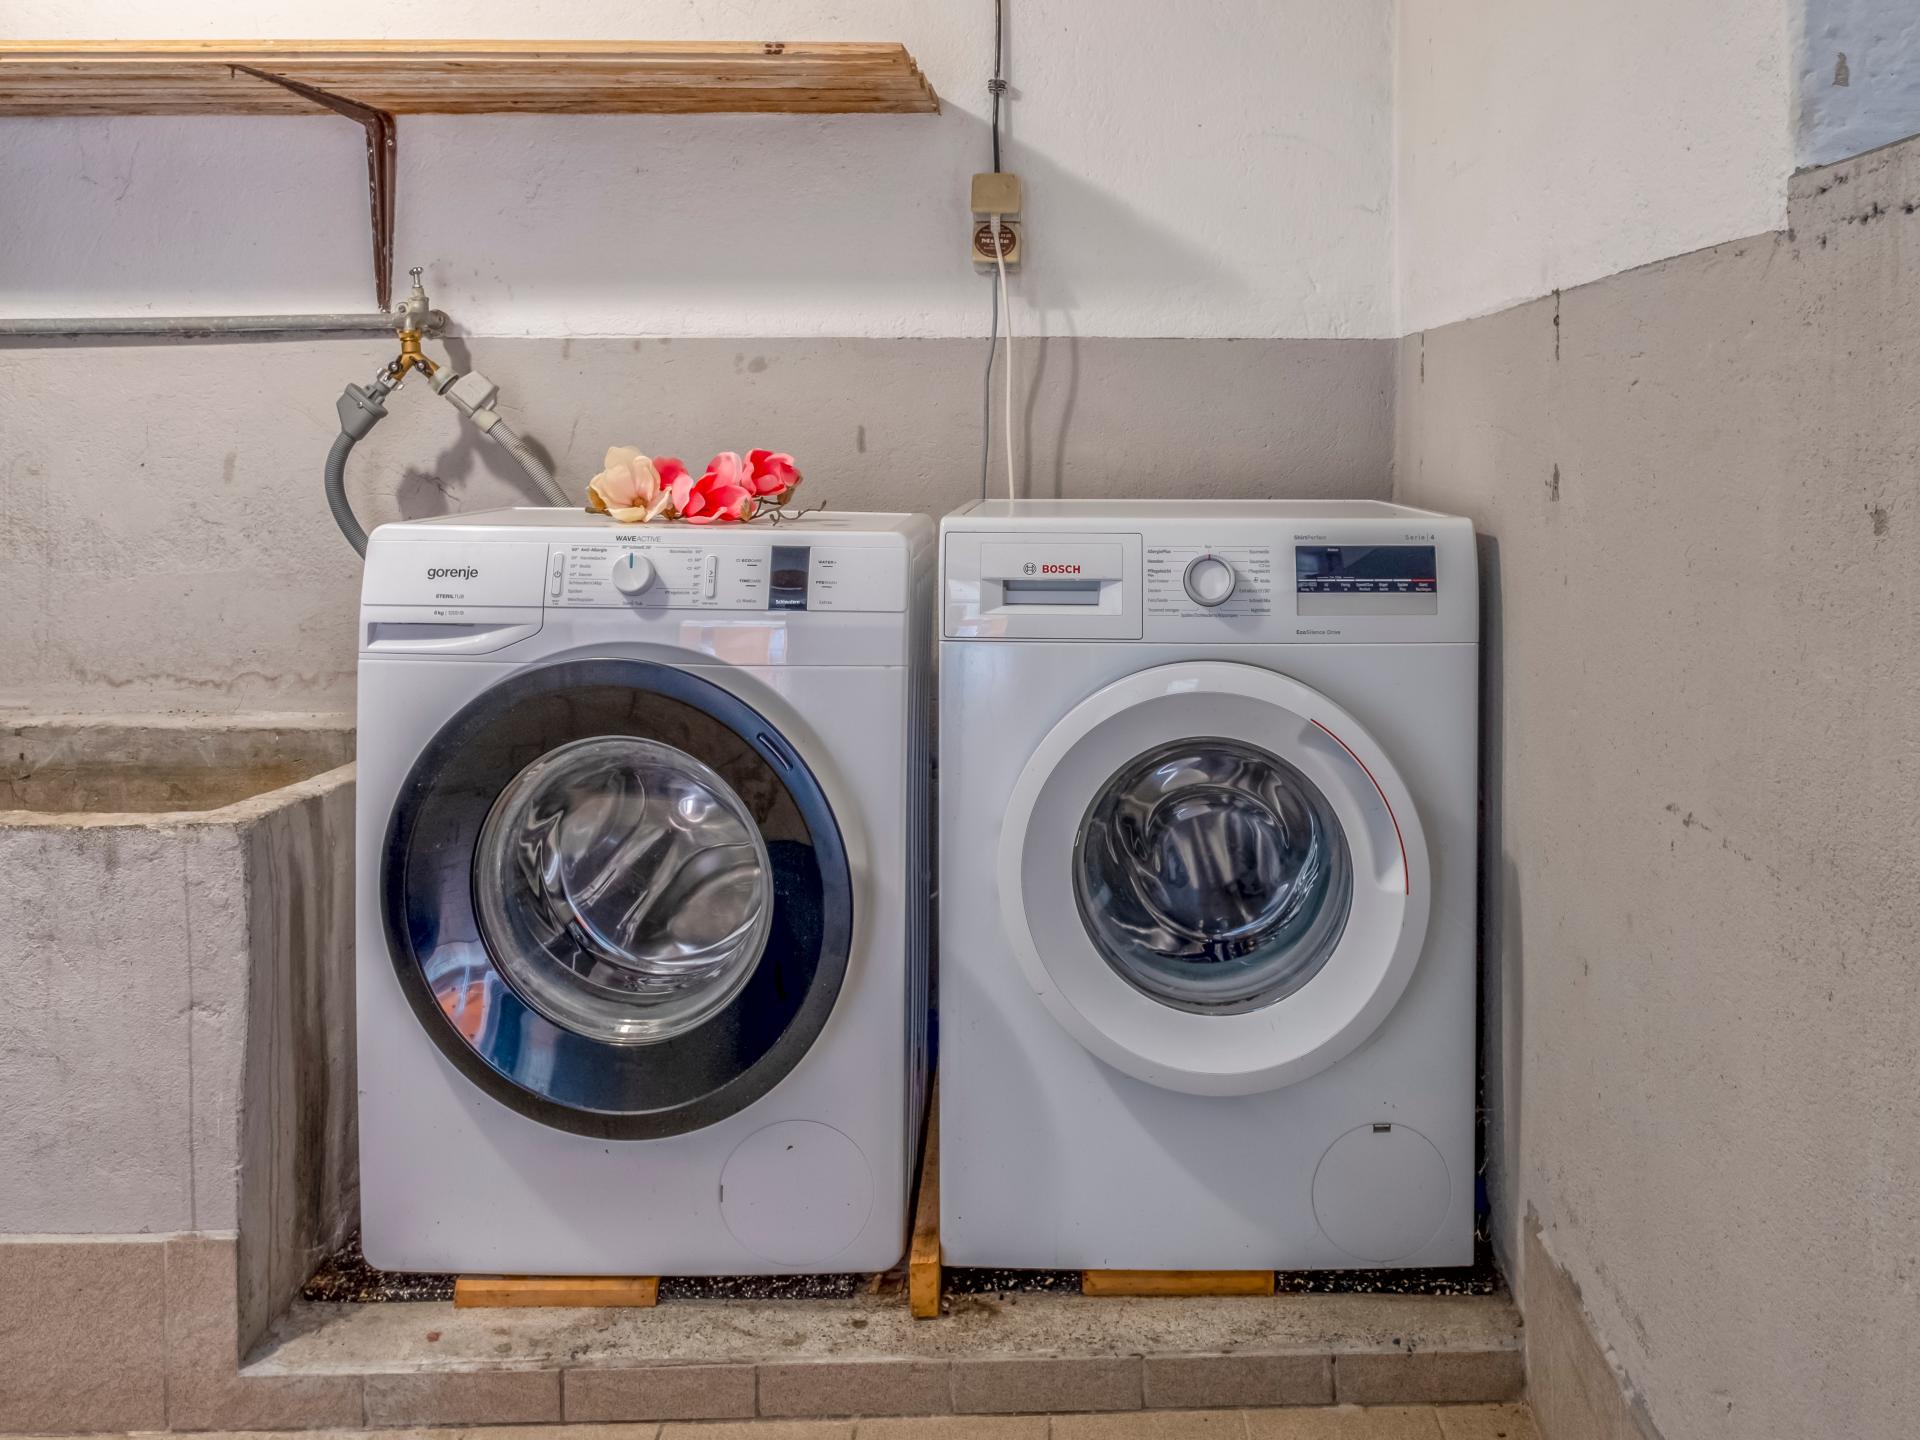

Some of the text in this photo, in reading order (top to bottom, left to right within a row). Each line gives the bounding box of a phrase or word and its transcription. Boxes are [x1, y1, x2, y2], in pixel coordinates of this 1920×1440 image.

[615, 535, 662, 543] WAVEACTIVE
[427, 565, 479, 581] gorenje
[1042, 564, 1081, 574] BOSCH
